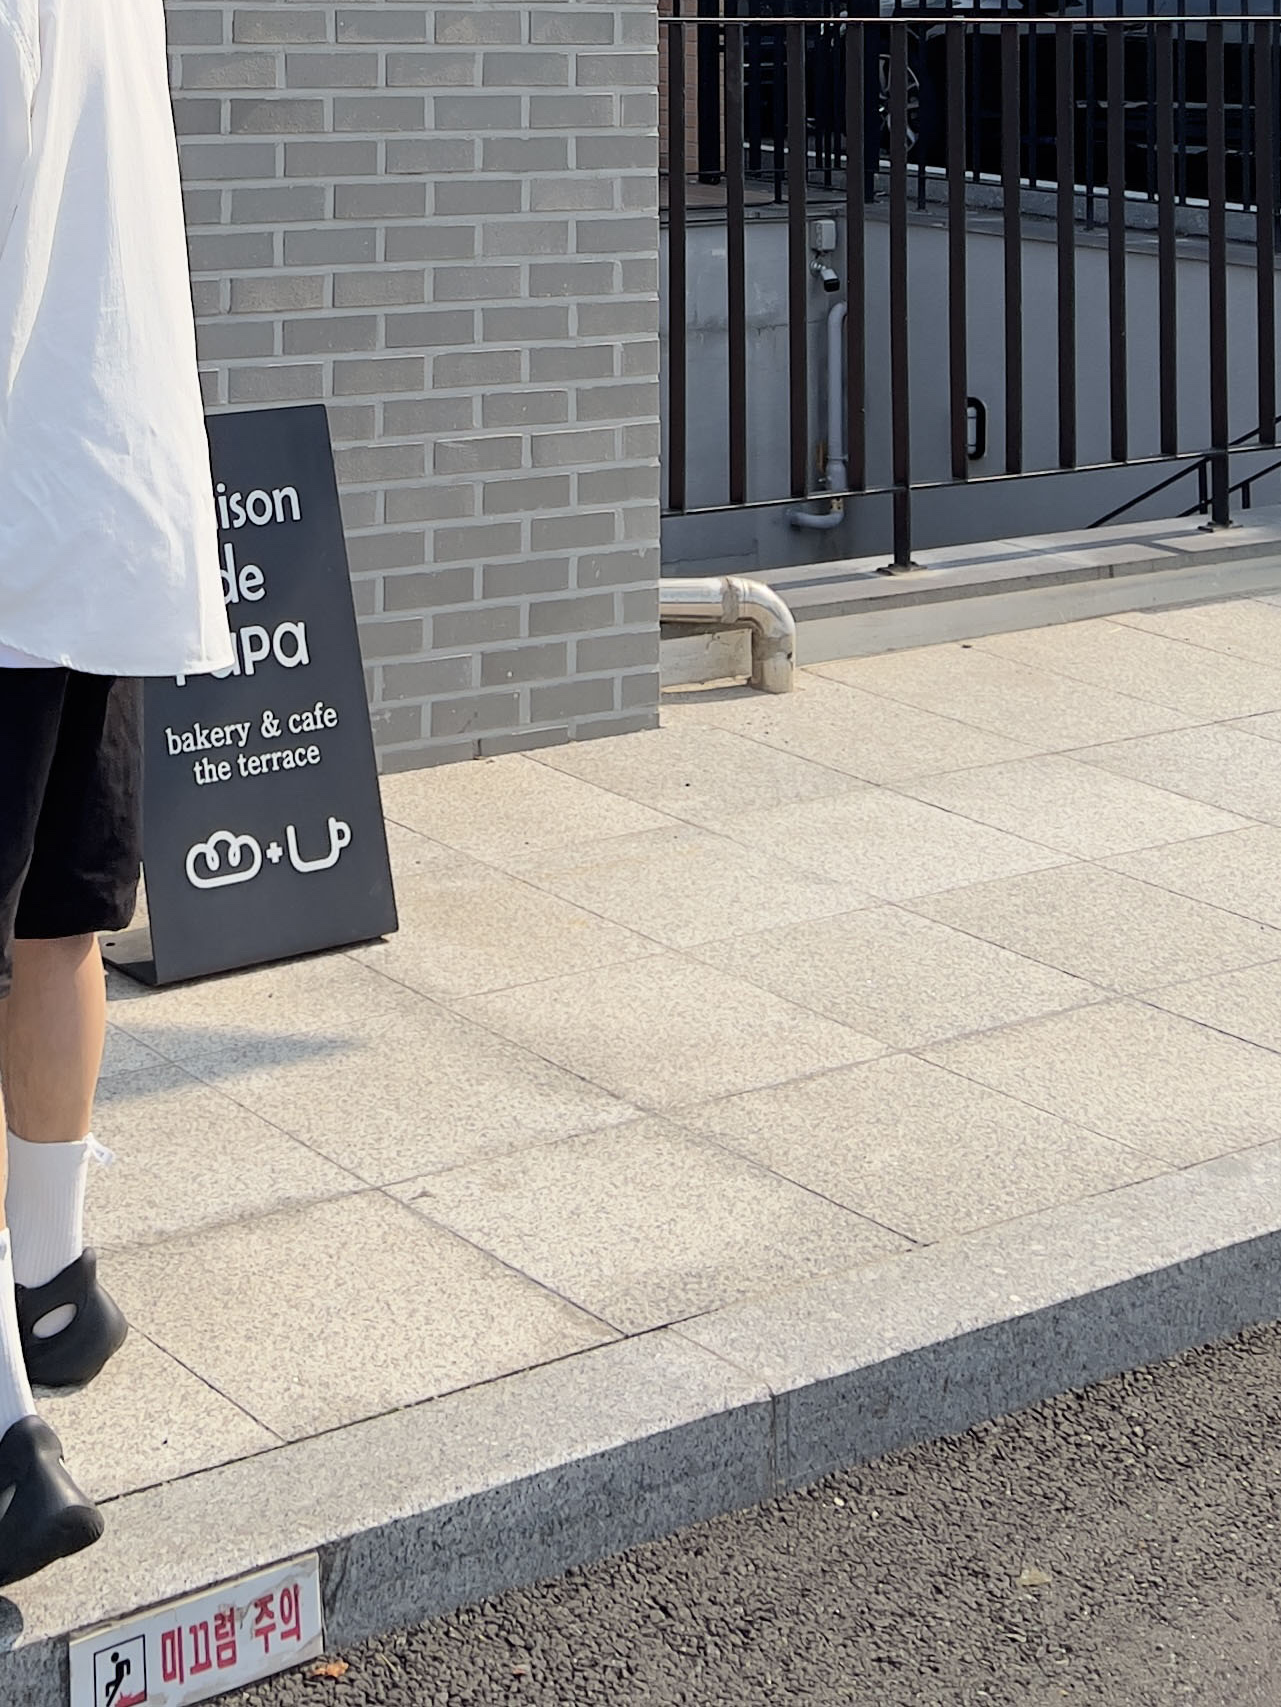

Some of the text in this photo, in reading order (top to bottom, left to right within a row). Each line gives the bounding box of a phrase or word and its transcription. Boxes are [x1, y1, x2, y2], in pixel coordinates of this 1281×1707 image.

[216, 483, 301, 530] ison
[220, 543, 266, 604] de
[165, 702, 338, 755] bakery & cafe
[193, 745, 321, 785] the terrace
[161, 1583, 301, 1684] 미끄럼 주의
